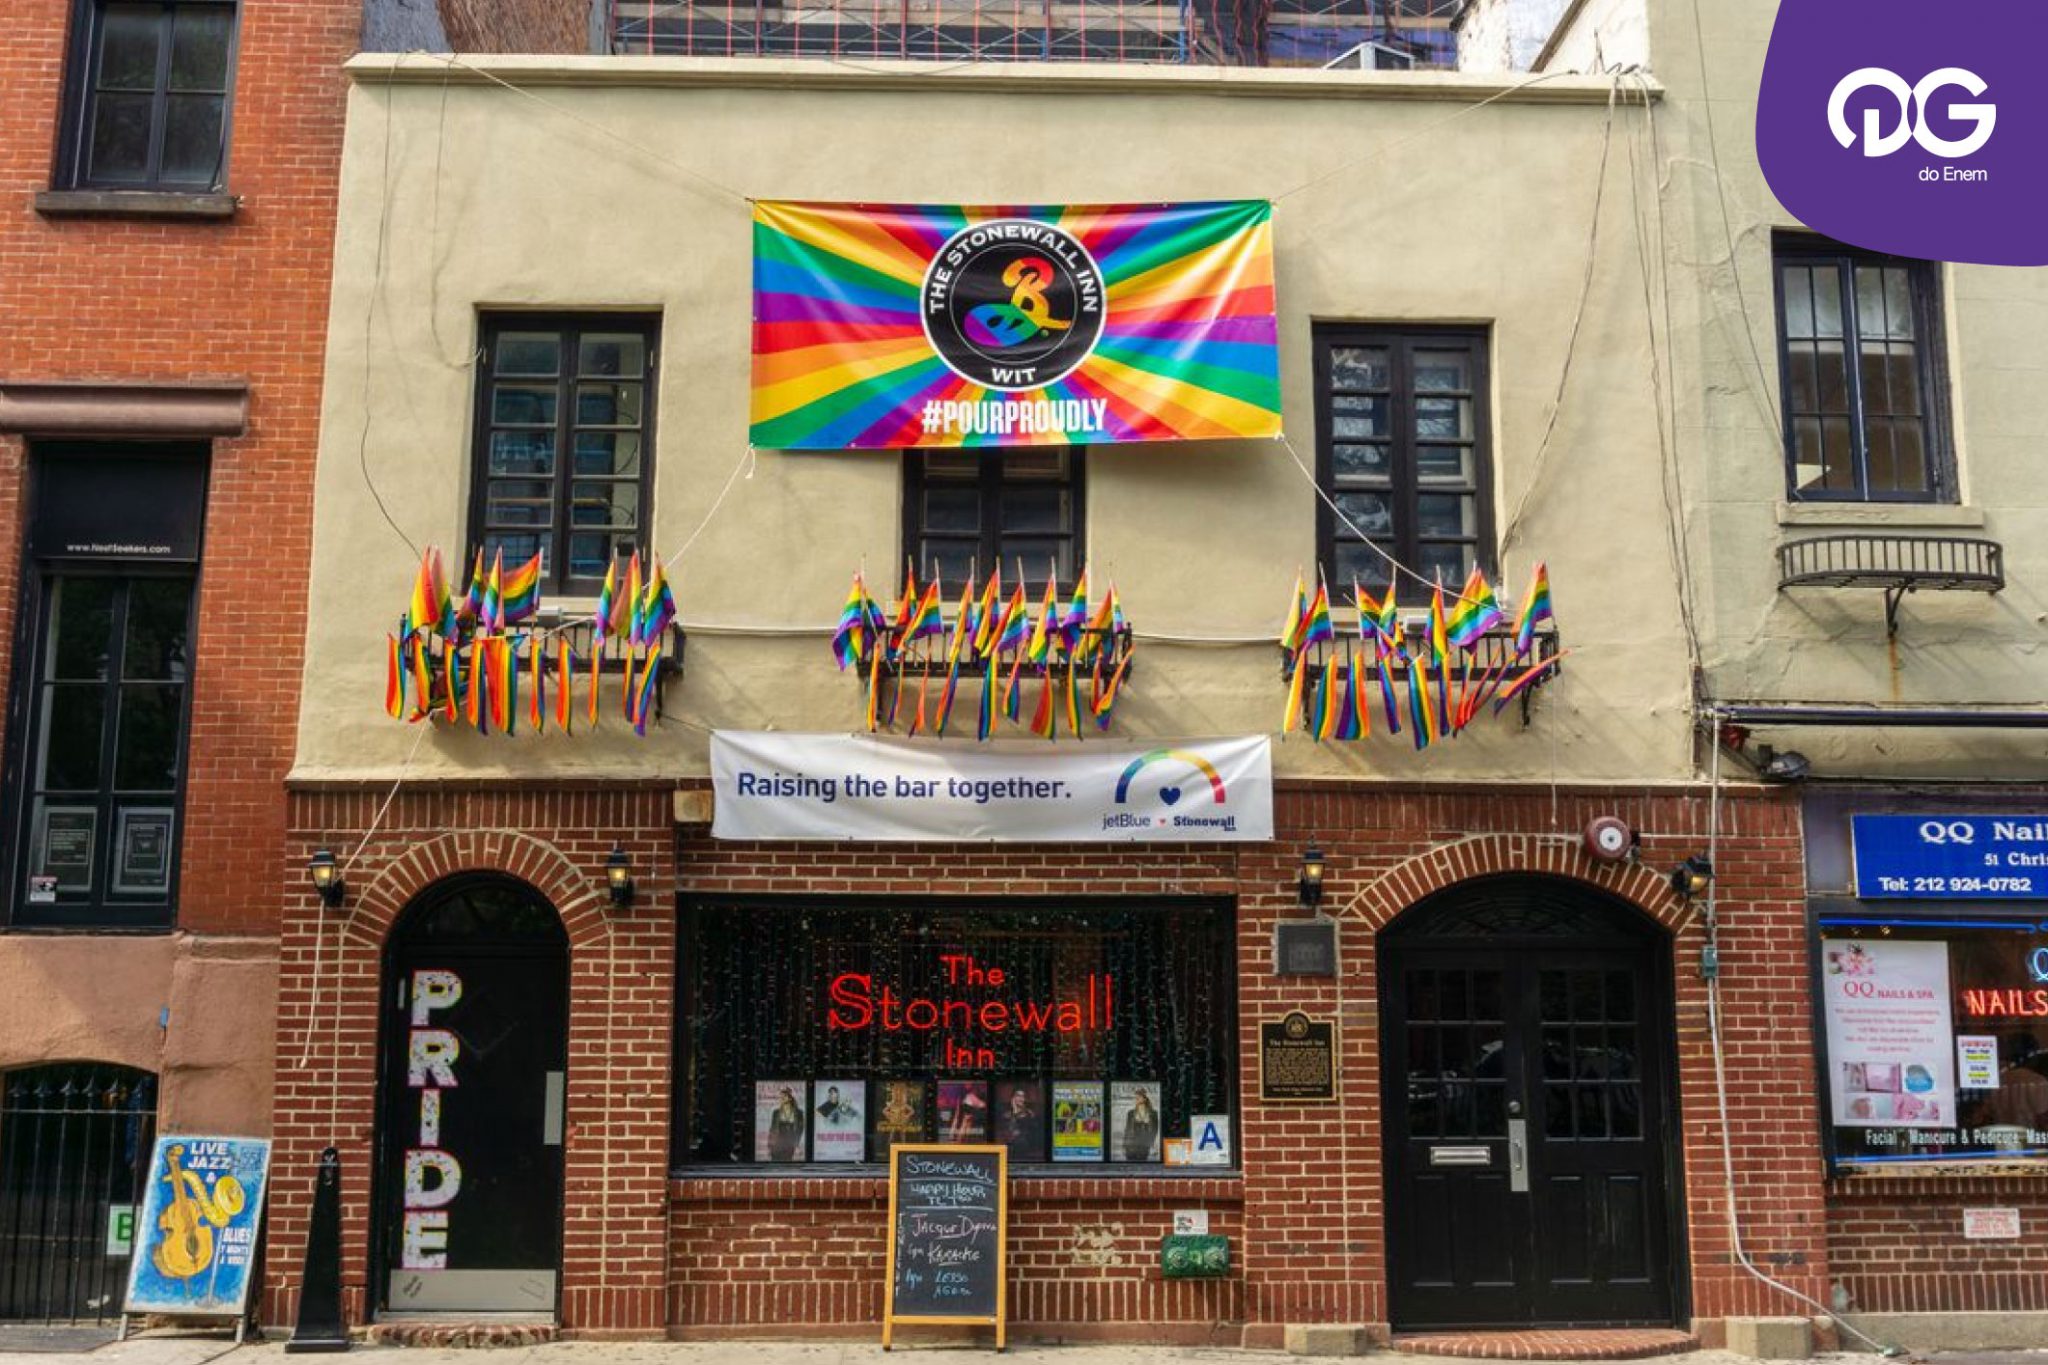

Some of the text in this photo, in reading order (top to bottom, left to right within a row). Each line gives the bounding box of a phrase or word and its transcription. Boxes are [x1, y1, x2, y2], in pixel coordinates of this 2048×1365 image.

[929, 225, 1098, 313] THE STONEWALL INN
[991, 368, 1036, 383] WIT
[921, 399, 1107, 434] #POURPROUDLY
[737, 772, 1072, 804] Raising the bar together.
[1102, 813, 1150, 830] jetBlue
[1173, 815, 1235, 827] Stonewall
[1919, 821, 1975, 845] QQ
[1984, 853, 1999, 867] 51
[1879, 877, 2032, 892] Tel: 212 924-0782
[939, 955, 1006, 985] The
[828, 971, 1112, 1031] Stonewall
[1844, 981, 1874, 998] QQ
[1878, 989, 1905, 998] NAILS
[1967, 989, 2048, 1016] NAILS
[946, 1038, 995, 1069] Inn
[402, 970, 463, 1270] PRIDE
[1198, 1120, 1223, 1151] A
[1866, 1130, 1897, 1145] Facial
[1961, 1129, 1969, 1144] &
[191, 1142, 228, 1155] LIVE
[188, 1157, 231, 1169] JAZZ
